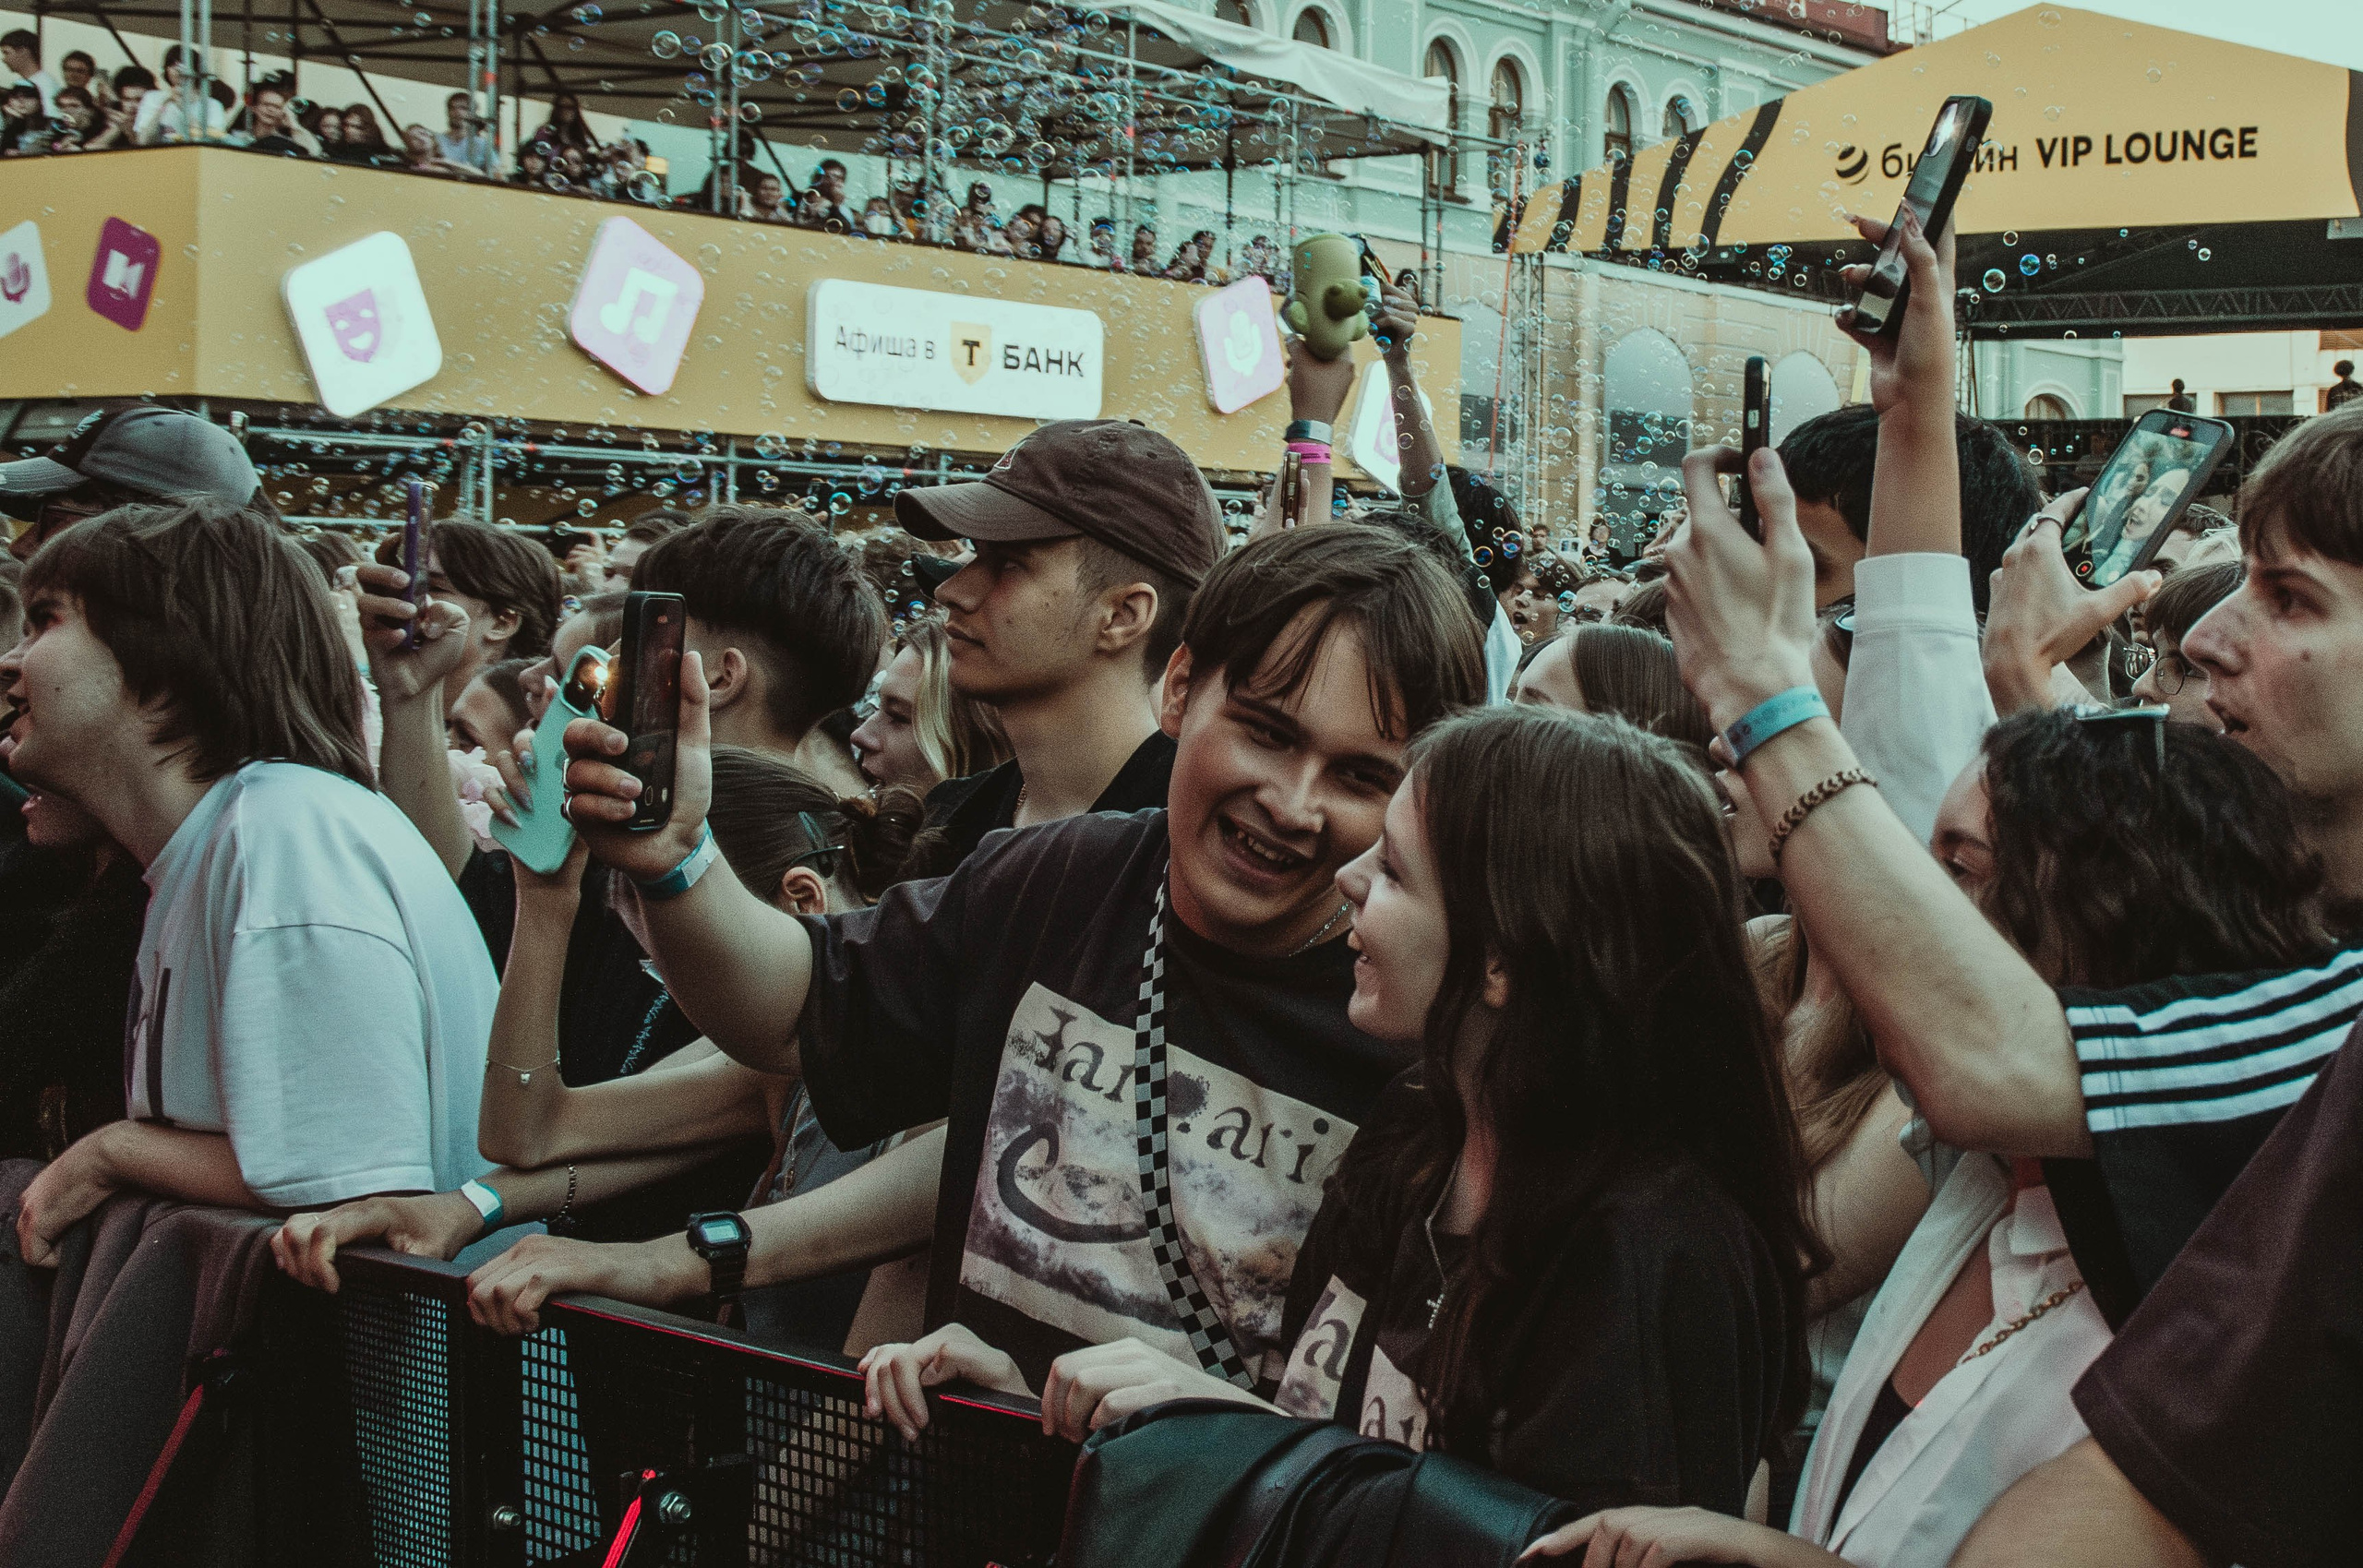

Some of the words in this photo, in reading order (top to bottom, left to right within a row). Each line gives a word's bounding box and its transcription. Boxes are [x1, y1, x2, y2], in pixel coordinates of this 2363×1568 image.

[2035, 135, 2093, 168] VIP
[2104, 126, 2259, 165] LOUNGE
[835, 326, 917, 361] Афиша
[924, 341, 936, 360] в
[1003, 344, 1085, 377] БАНК
